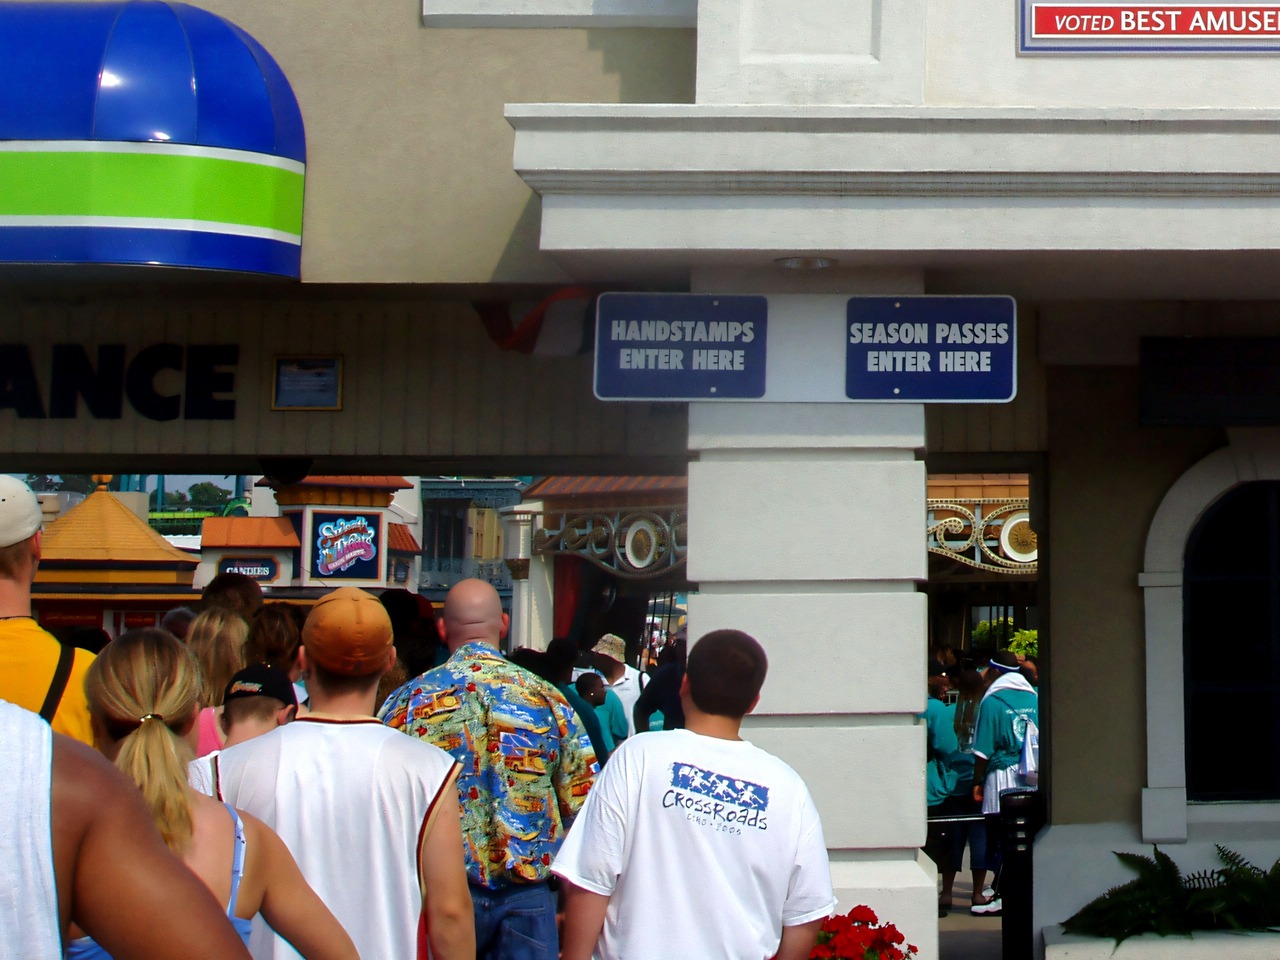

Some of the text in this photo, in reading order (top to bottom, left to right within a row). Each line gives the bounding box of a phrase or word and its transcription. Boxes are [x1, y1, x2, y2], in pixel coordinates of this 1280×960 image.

[1055, 14, 1114, 31] VOTED
[1121, 10, 1181, 31] BEST
[611, 320, 755, 343] HANDSTAMPS
[849, 323, 1009, 345] SEASON PASSES
[619, 349, 745, 371] ENTER HERE
[867, 351, 991, 372] ENTER HERE
[226, 566, 270, 576] CANDIES
